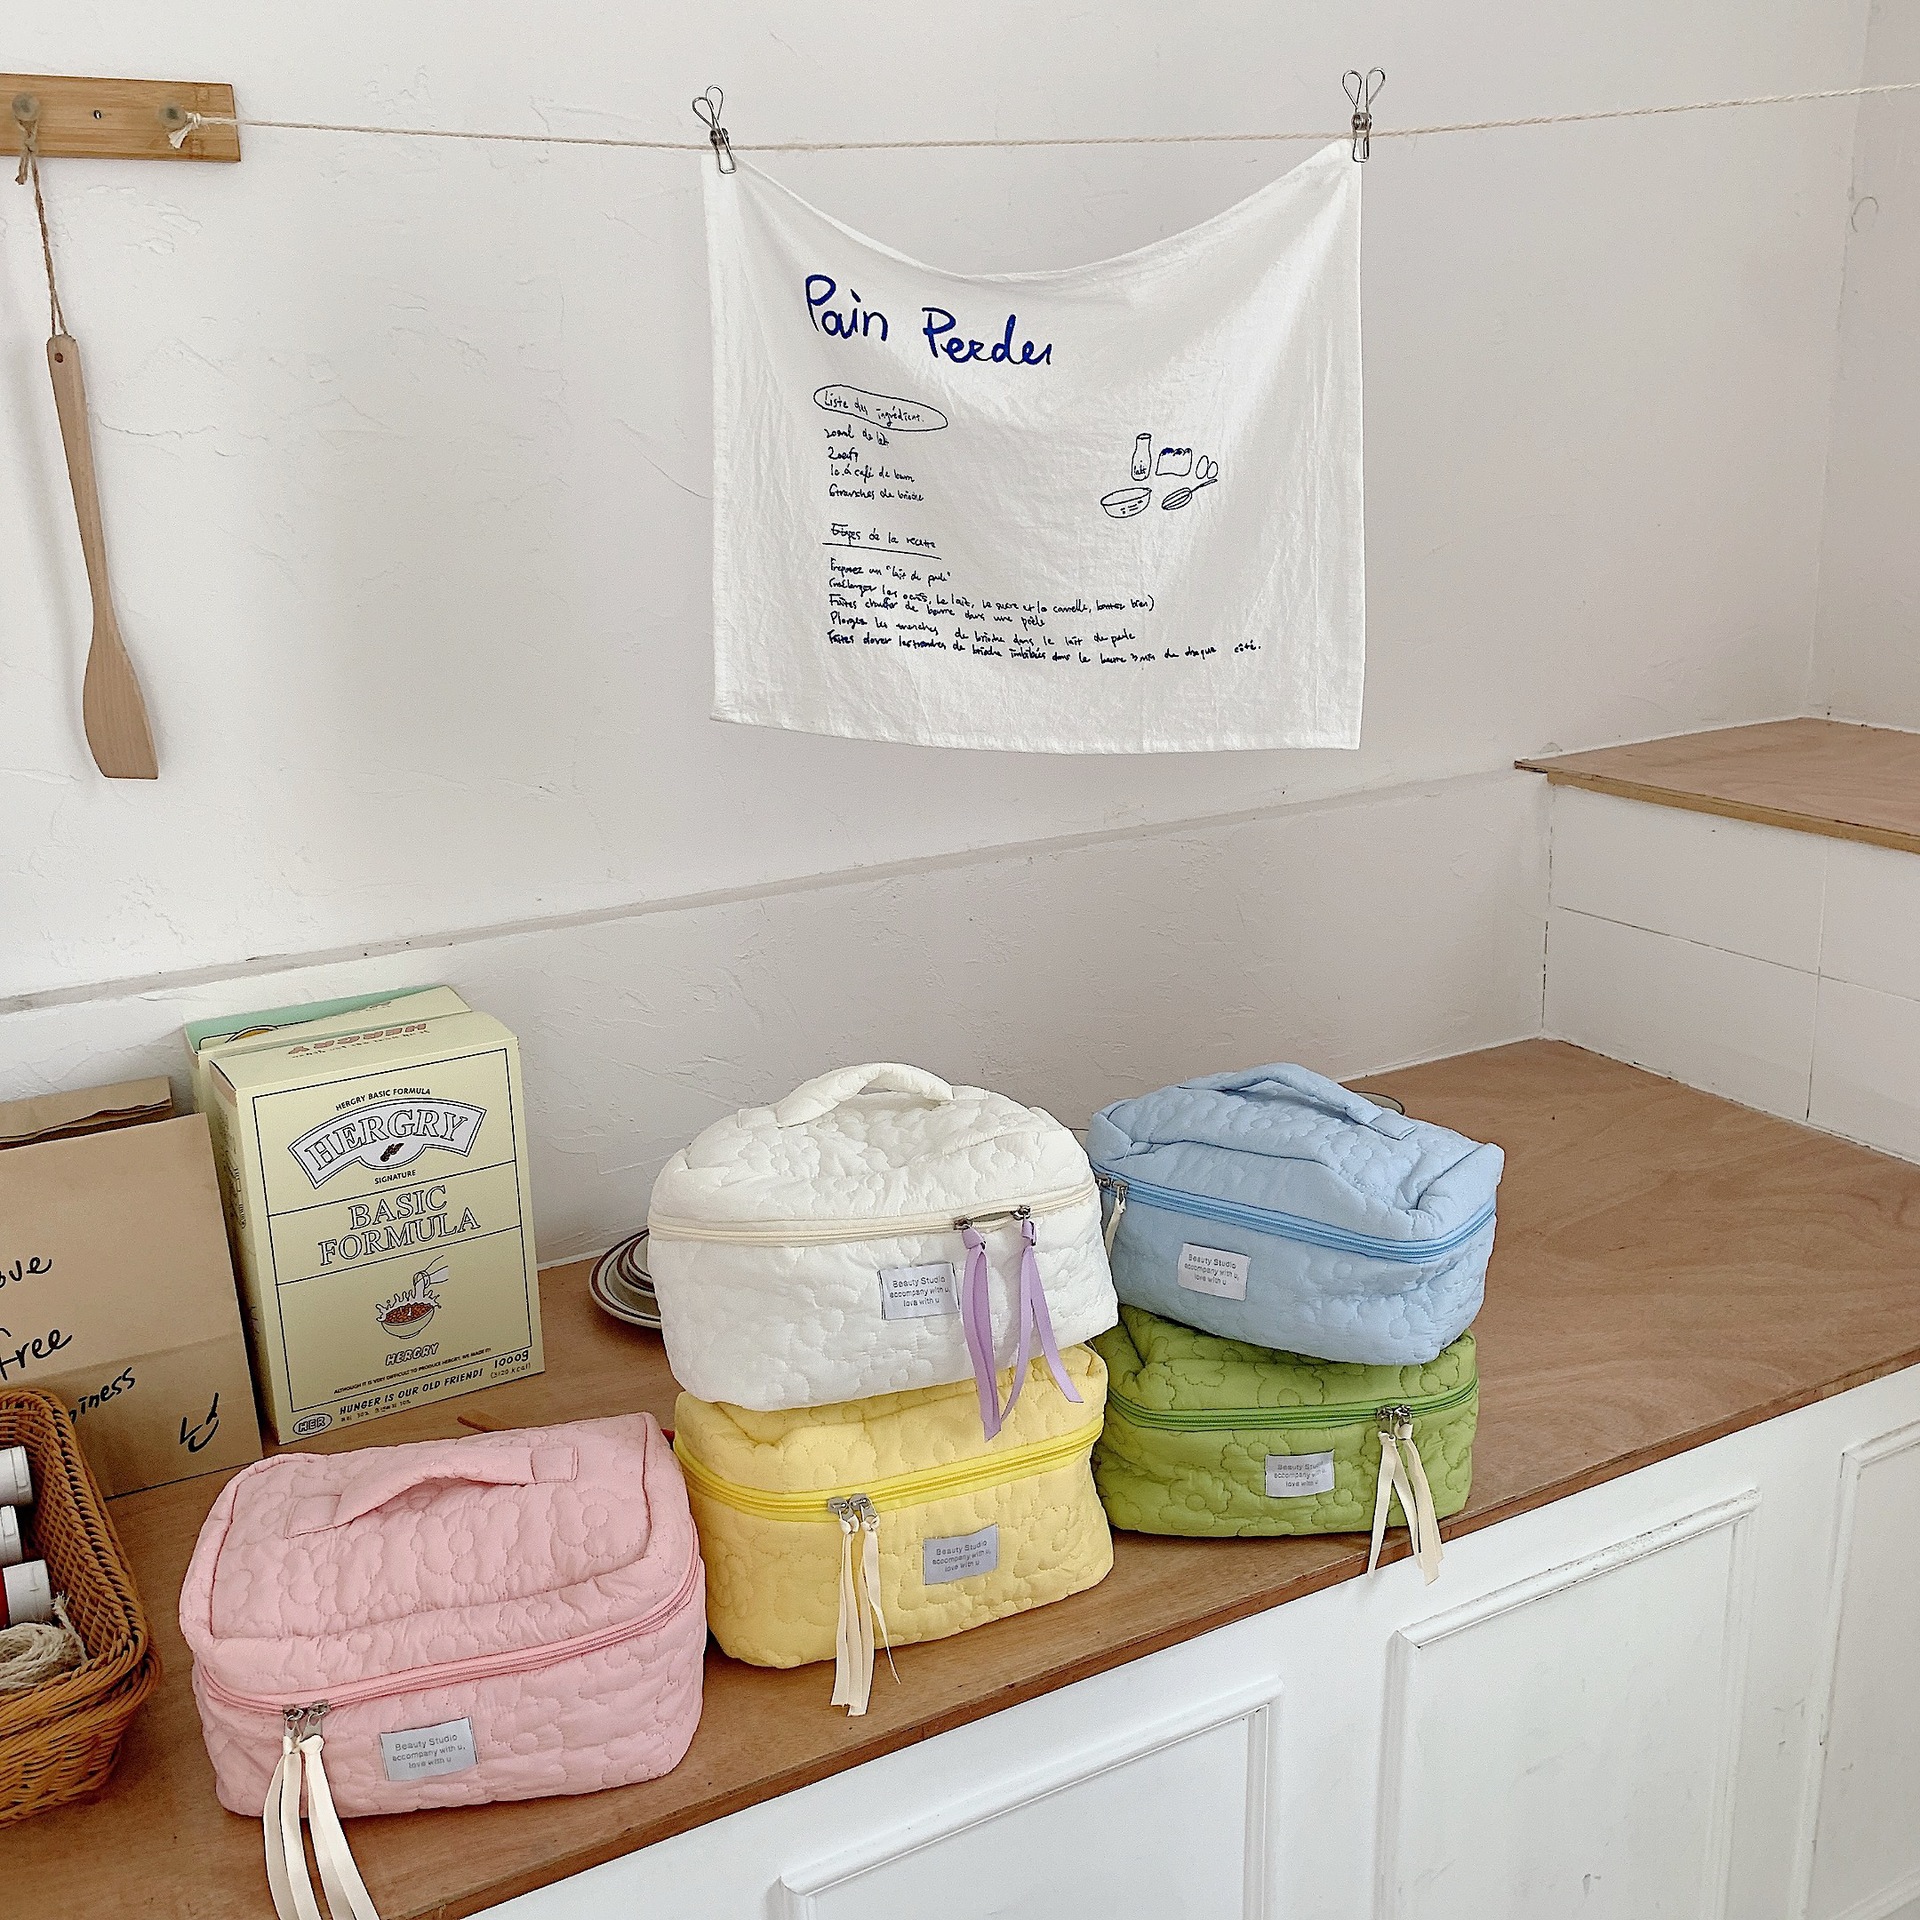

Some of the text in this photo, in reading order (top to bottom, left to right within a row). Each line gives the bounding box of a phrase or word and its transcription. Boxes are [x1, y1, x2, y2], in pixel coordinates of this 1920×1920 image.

[804, 274, 889, 342] Pain
[335, 1087, 431, 1112] HERGRY BASIC FORMULA
[303, 1109, 468, 1172] HERGRY
[374, 1169, 417, 1185] SIGNATURE
[348, 1184, 448, 1231] BASIC
[317, 1206, 482, 1267] FORMULA
[1188, 1253, 1237, 1270] Beauty Studio
[892, 1275, 946, 1289] Beauty Studio
[385, 1342, 439, 1366] HERGRY
[494, 1350, 529, 1369] 1000g
[339, 1396, 381, 1416] HUNGER
[384, 1393, 395, 1403] IS
[397, 1386, 419, 1400] OUR
[422, 1380, 441, 1392] OLD
[444, 1368, 484, 1387] FRIEND!
[298, 1416, 326, 1432] HER
[936, 1540, 988, 1556] Beauty Studio
[395, 1733, 458, 1752] Beauty Studio
[392, 1748, 438, 1763] accompany
[439, 1744, 456, 1755] with
[408, 1760, 427, 1769] love
[427, 1756, 446, 1767] with
